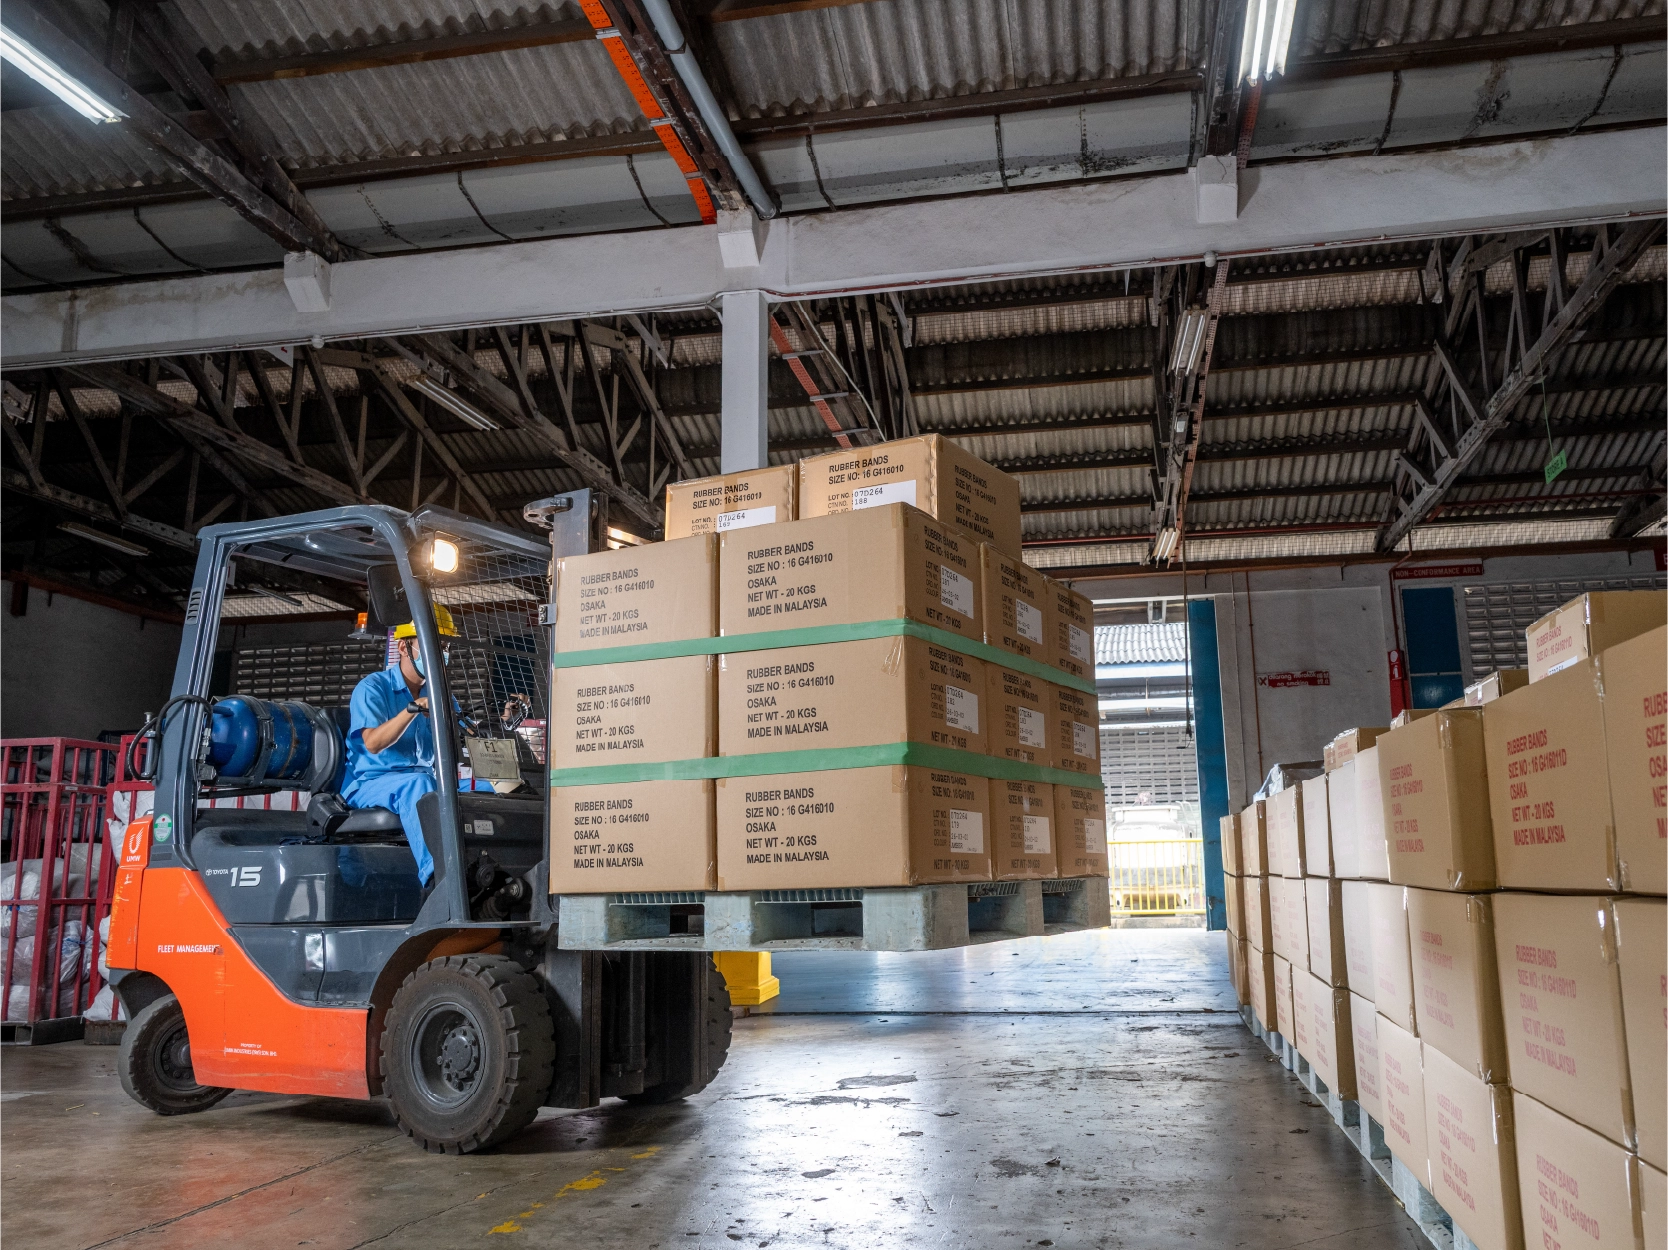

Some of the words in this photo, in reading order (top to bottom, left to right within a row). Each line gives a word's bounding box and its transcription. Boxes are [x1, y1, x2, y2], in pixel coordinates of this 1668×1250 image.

[829, 460, 860, 472] RUBBER
[862, 455, 888, 467] BANDS
[828, 473, 845, 484] SIZE
[862, 469, 870, 478] 16
[872, 464, 903, 476] G416010
[693, 487, 722, 498] RUBBER
[724, 482, 748, 494] BANDS
[854, 487, 882, 498] 07D264
[692, 499, 707, 509] SIZE
[724, 496, 731, 504] 16
[747, 546, 782, 559] RUBBER
[784, 541, 813, 554] BANDS
[747, 562, 765, 574] SIZE
[787, 558, 796, 567] 16
[798, 552, 832, 566] G416010
[580, 572, 610, 584] RUBBER
[612, 568, 638, 580] BANDS
[1396, 567, 1460, 577] NON-CONFORMANCE
[747, 576, 776, 588] OSAKA
[580, 588, 596, 598] SIZE
[614, 584, 622, 593] 16
[747, 592, 763, 602] NET
[765, 589, 778, 599] WT
[785, 587, 794, 597] 20
[797, 584, 815, 595] KGS
[580, 600, 605, 611] OSAKA
[747, 605, 771, 617] MADE
[773, 603, 782, 613] IN
[784, 597, 827, 612] MALAYSIA
[580, 615, 594, 624] NET
[595, 613, 607, 623] WT
[612, 611, 620, 621] 20
[622, 609, 638, 620] KGS
[580, 627, 600, 638] MADE
[602, 626, 609, 635] IN
[610, 622, 648, 634] MALAYSIA
[746, 666, 781, 679] RUBBER
[784, 662, 814, 674] BANDS
[577, 686, 606, 697] RUBBER
[608, 683, 634, 694] BANDS
[746, 682, 764, 693] SIZE
[787, 679, 796, 688] 16
[798, 675, 834, 687] G416010
[576, 701, 591, 712] SIZE
[610, 698, 618, 708] 16
[620, 695, 650, 707] G416010
[747, 696, 776, 708] OSAKA
[576, 715, 601, 725] OSAKA
[747, 712, 763, 722] NET
[764, 711, 778, 720] WT
[786, 709, 795, 719] 20
[797, 707, 816, 718] KGS
[576, 729, 589, 739] NET
[591, 728, 603, 737] WT
[608, 726, 616, 736] 20
[618, 725, 634, 735] KGS
[747, 726, 771, 738] MADE
[773, 725, 782, 735] IN
[784, 721, 828, 734] MALAYSIA
[484, 742, 497, 752] F1
[575, 742, 596, 752] MADE
[597, 742, 605, 750] IN
[607, 739, 644, 749] MALAYSIA
[1506, 736, 1527, 755] RUBBER
[1528, 729, 1547, 749] BANDS
[1508, 761, 1518, 779] SIZE
[1531, 756, 1538, 772] 16
[745, 790, 781, 802] RUBBER
[783, 787, 814, 799] BANDS
[1509, 782, 1528, 800] OSAKA
[574, 800, 604, 811] RUBBER
[606, 799, 632, 809] BANDS
[745, 807, 763, 818] SIZE
[786, 804, 795, 815] 16
[797, 802, 834, 814] G416010
[1511, 806, 1521, 822] NET
[1521, 804, 1530, 821] WT
[1534, 803, 1541, 819] 20
[1541, 801, 1554, 818] KGS
[574, 816, 589, 825] SIZE
[609, 814, 616, 823] 16
[618, 813, 649, 823] G416010
[745, 821, 776, 832] OSAKA
[574, 829, 599, 840] OSAKA
[746, 838, 762, 848] NET
[764, 837, 778, 847] WT
[785, 836, 794, 846] 20
[797, 835, 816, 846] KGS
[1513, 828, 1529, 845] MADE
[1528, 828, 1535, 845] IN
[1535, 825, 1565, 844] MALAYSIA
[574, 844, 587, 854] NET
[589, 844, 601, 854] WT
[607, 843, 615, 853] 20
[617, 843, 633, 853] KGS
[573, 858, 594, 868] MADE
[596, 858, 603, 867] IN
[606, 857, 643, 867] MALAYSIA
[746, 853, 771, 863] MADE
[773, 853, 782, 862] IN
[784, 850, 829, 861] MALAYSIA
[230, 866, 262, 887] 15
